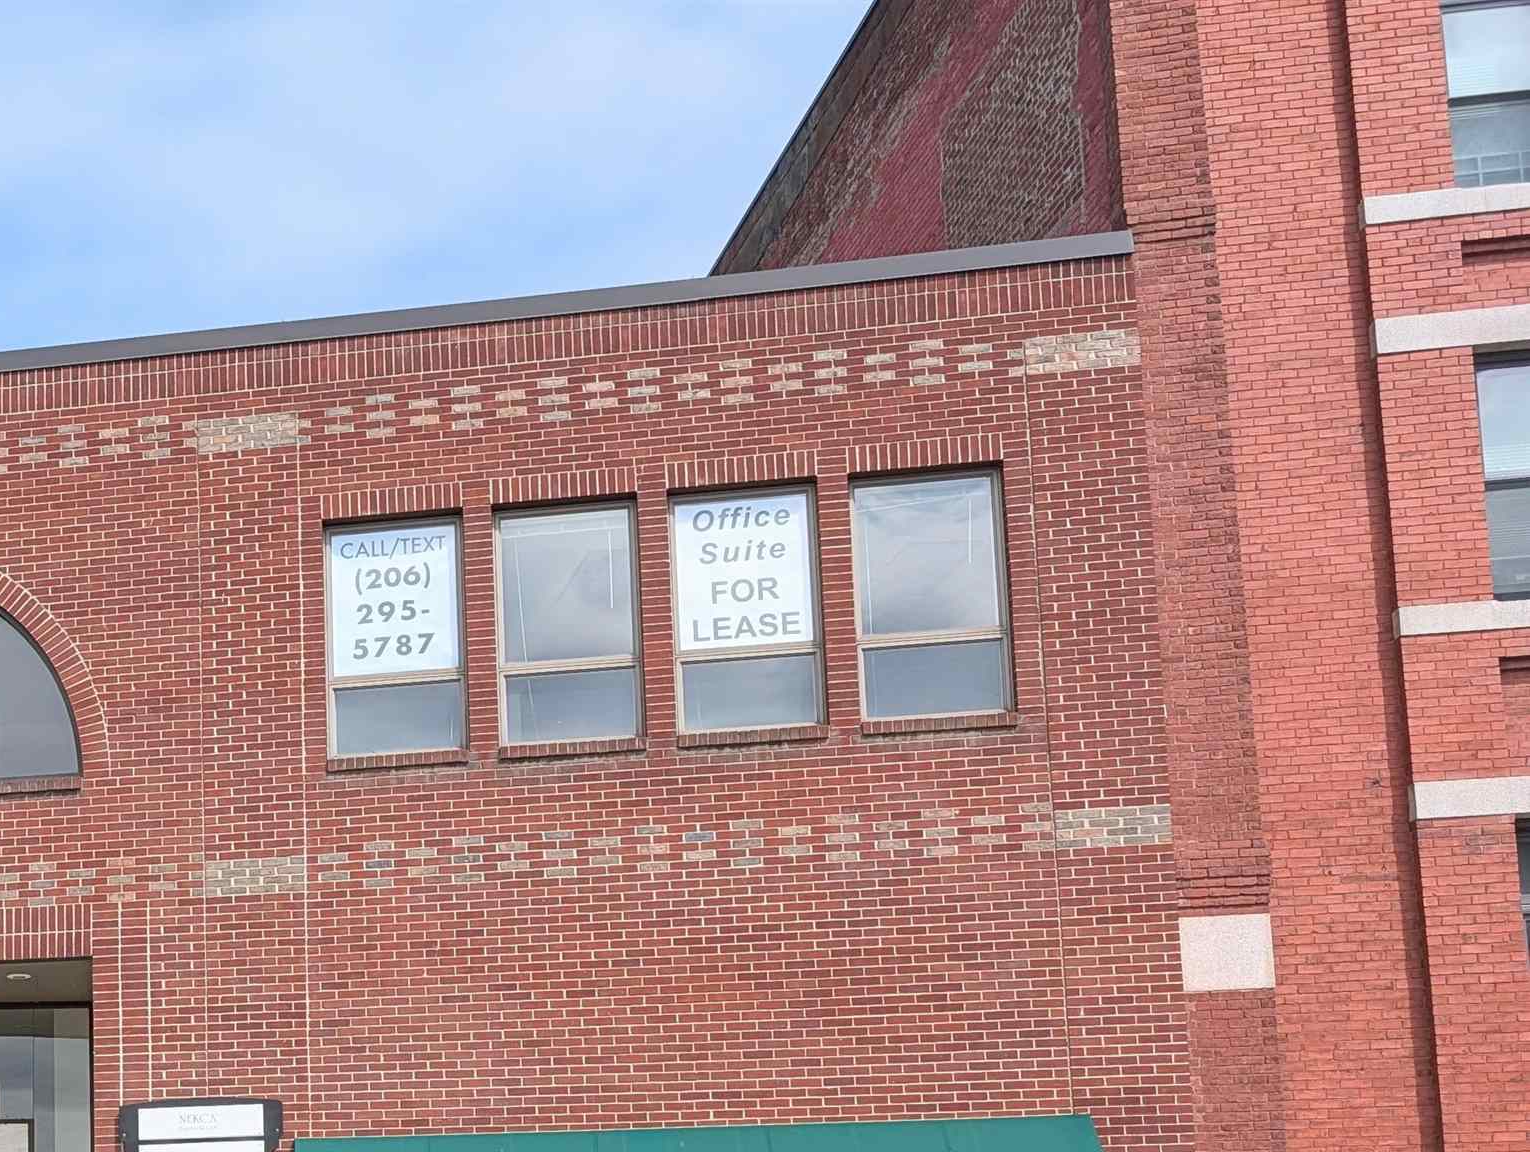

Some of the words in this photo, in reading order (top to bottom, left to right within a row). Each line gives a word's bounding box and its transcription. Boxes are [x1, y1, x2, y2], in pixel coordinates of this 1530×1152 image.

[692, 506, 791, 532] Office
[339, 535, 446, 560] CALL/TEXT
[699, 539, 786, 564] Suite
[355, 561, 431, 596] (206)
[711, 577, 780, 605] FOR
[356, 599, 430, 625] 295-
[692, 611, 802, 642] LEASE
[352, 632, 435, 660] 5787
